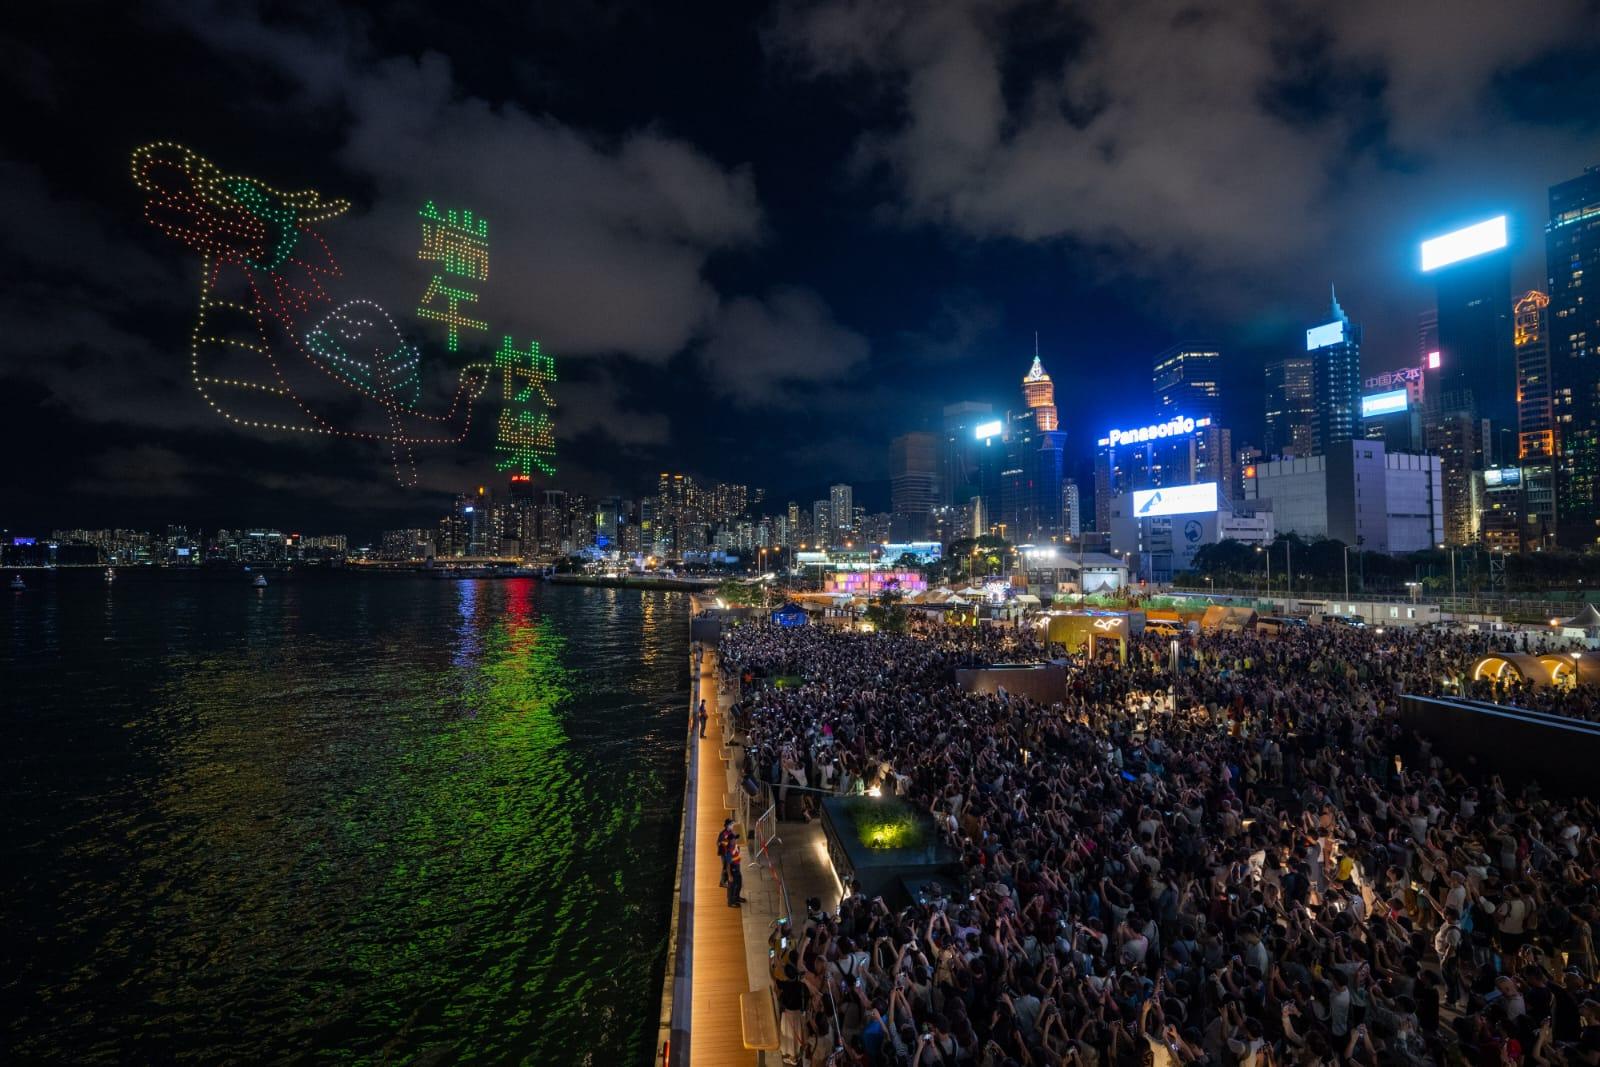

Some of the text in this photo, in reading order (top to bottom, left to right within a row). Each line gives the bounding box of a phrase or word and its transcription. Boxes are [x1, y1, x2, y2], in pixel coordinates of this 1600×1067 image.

[417, 200, 489, 351] 端午
[495, 335, 557, 475] 快樂
[1110, 415, 1194, 447] Panasonic
